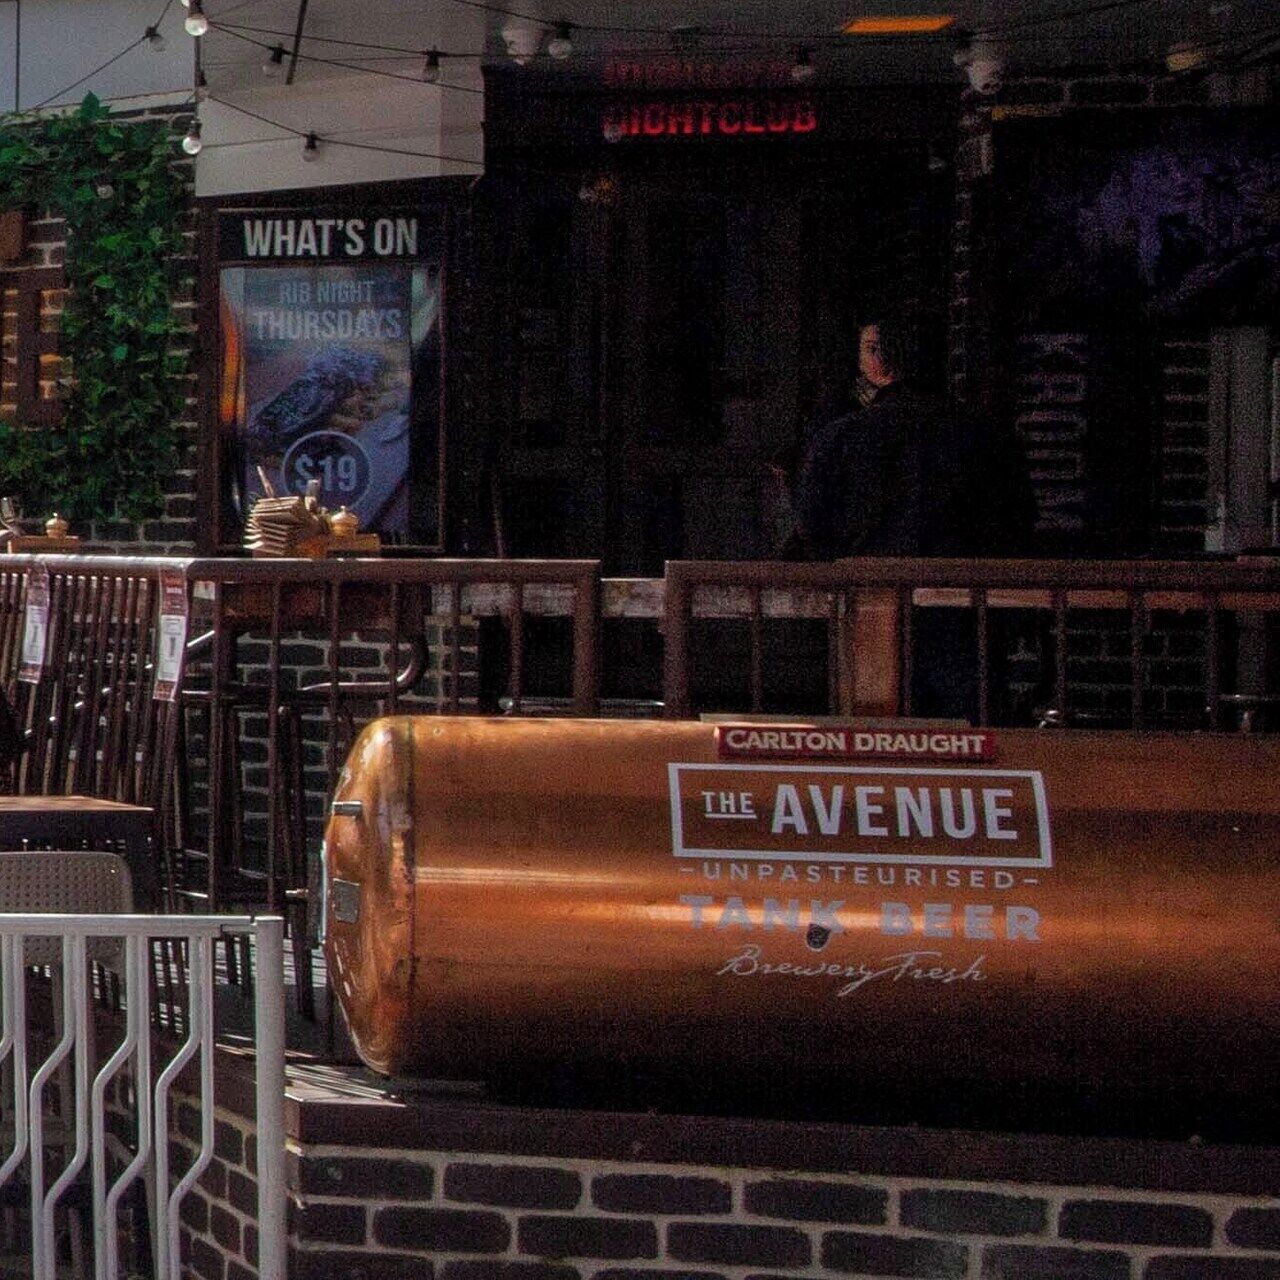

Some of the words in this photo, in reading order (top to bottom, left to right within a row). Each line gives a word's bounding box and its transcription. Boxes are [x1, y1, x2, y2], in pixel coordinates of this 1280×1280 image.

[373, 218, 418, 256] ON
[280, 280, 312, 303] RIB
[317, 280, 375, 303] NIGHT
[254, 310, 404, 340] THURSDAYS
[295, 453, 357, 492] $19
[726, 728, 846, 751] CARLTON
[854, 732, 986, 754] DRAUGHT
[701, 790, 756, 815] THE
[771, 783, 1018, 841] AVENUE
[678, 893, 846, 934] TANK
[881, 900, 1042, 941] BEER
[716, 943, 878, 997] Brewery
[878, 951, 988, 983] Fresh
